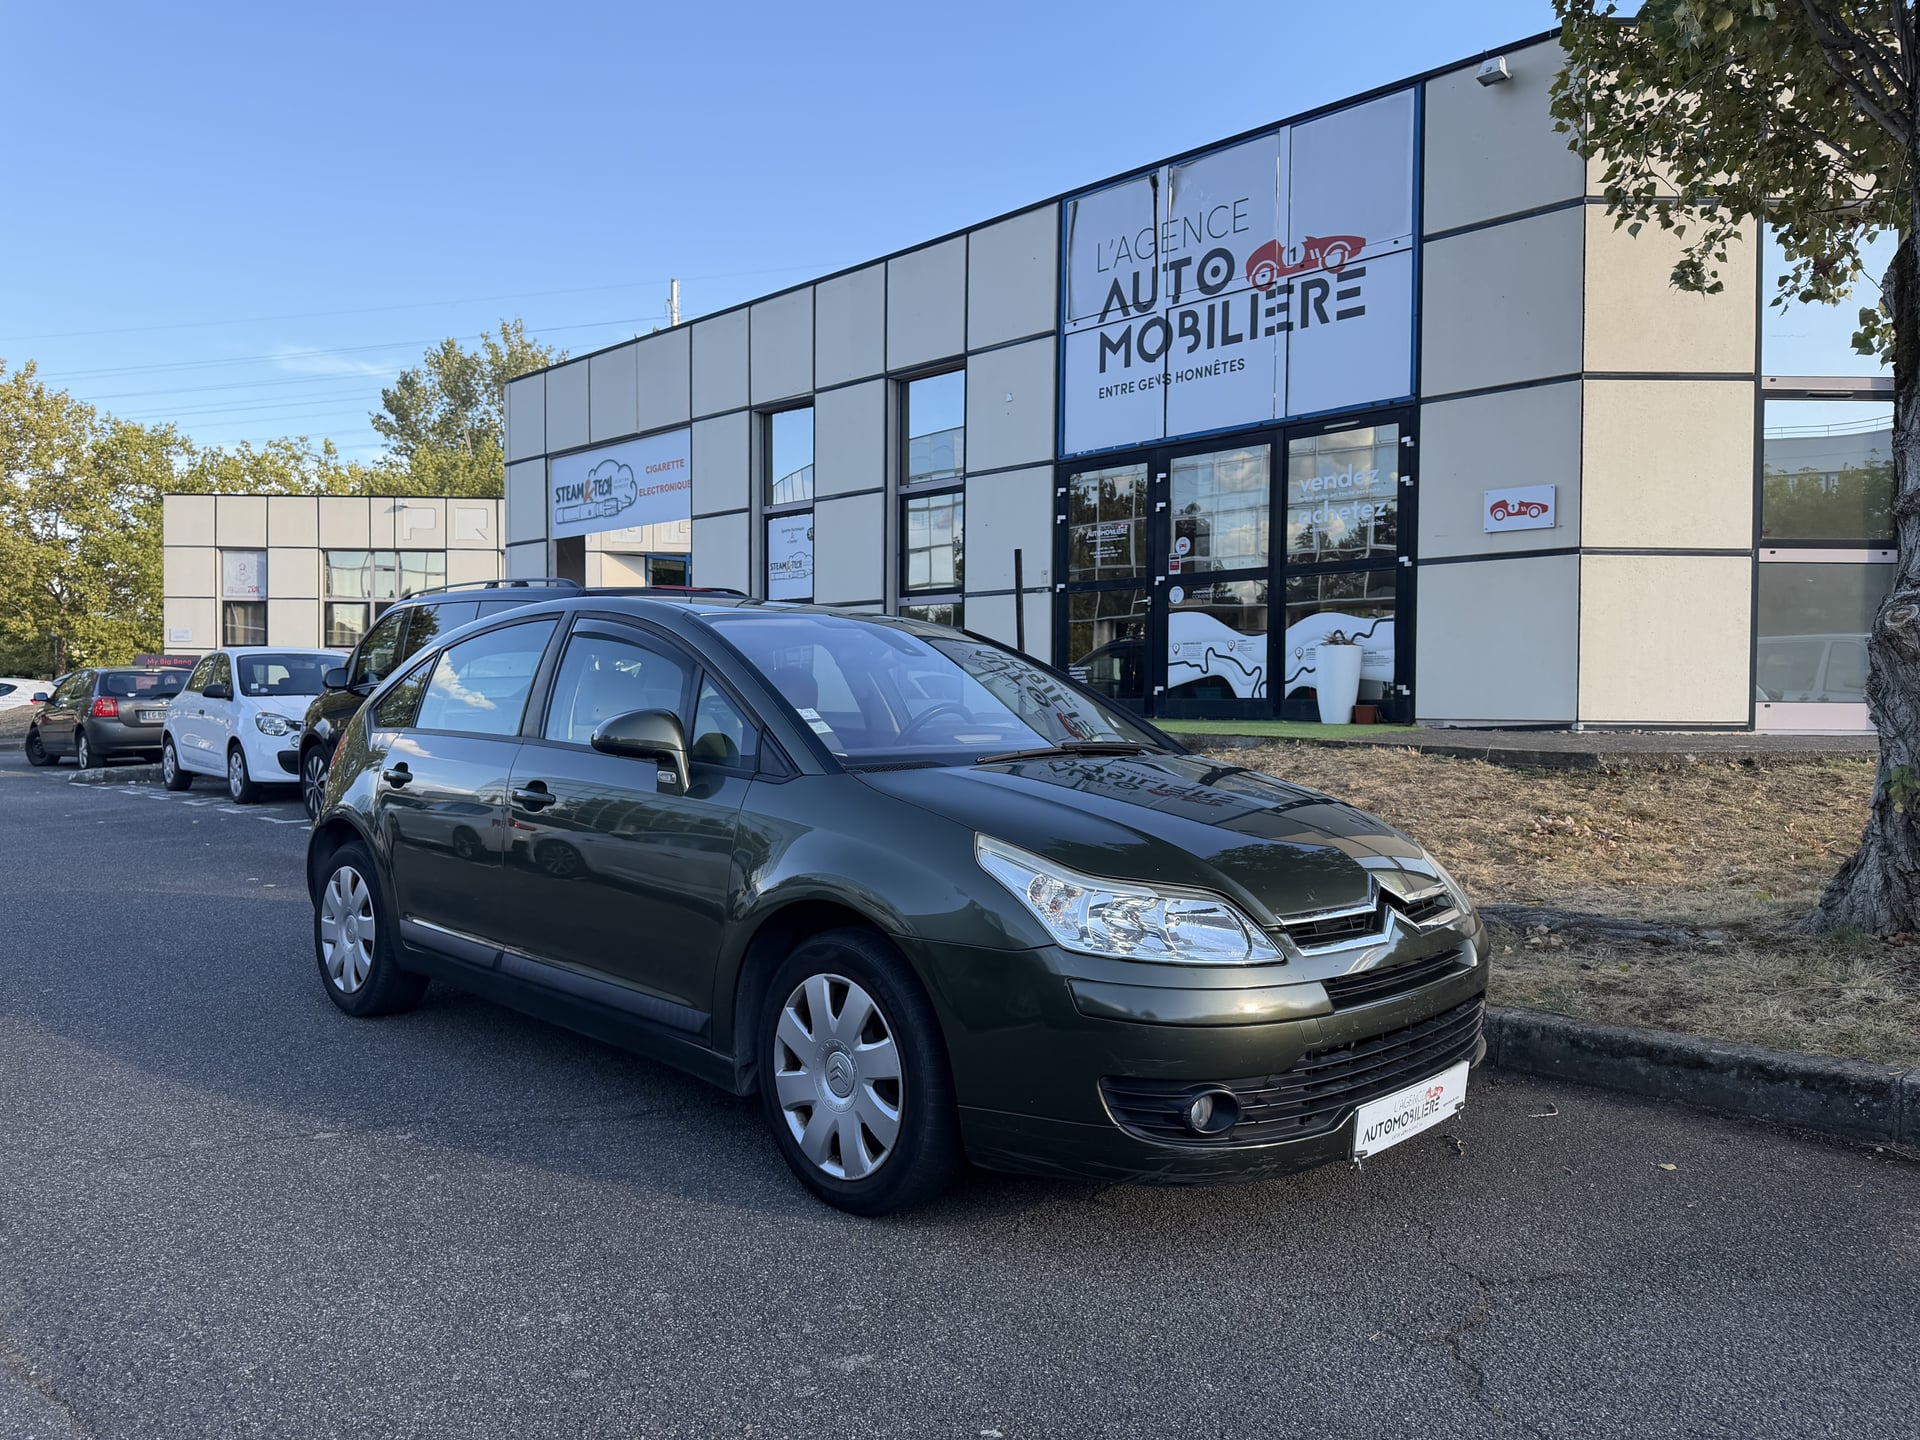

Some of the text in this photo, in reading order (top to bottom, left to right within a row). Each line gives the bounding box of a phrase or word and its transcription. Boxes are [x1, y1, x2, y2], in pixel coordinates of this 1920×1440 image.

[1097, 198, 1249, 273] L'AGENCE
[1098, 248, 1236, 323] AUTO
[1098, 358, 1246, 399] ENTRE GENS HONNÊTES
[645, 459, 685, 474] CIGARETTE
[1300, 463, 1379, 492] vendez
[638, 480, 692, 497] ELECTRONIQUE
[1299, 500, 1387, 526] achetez
[160, 658, 172, 666] Big
